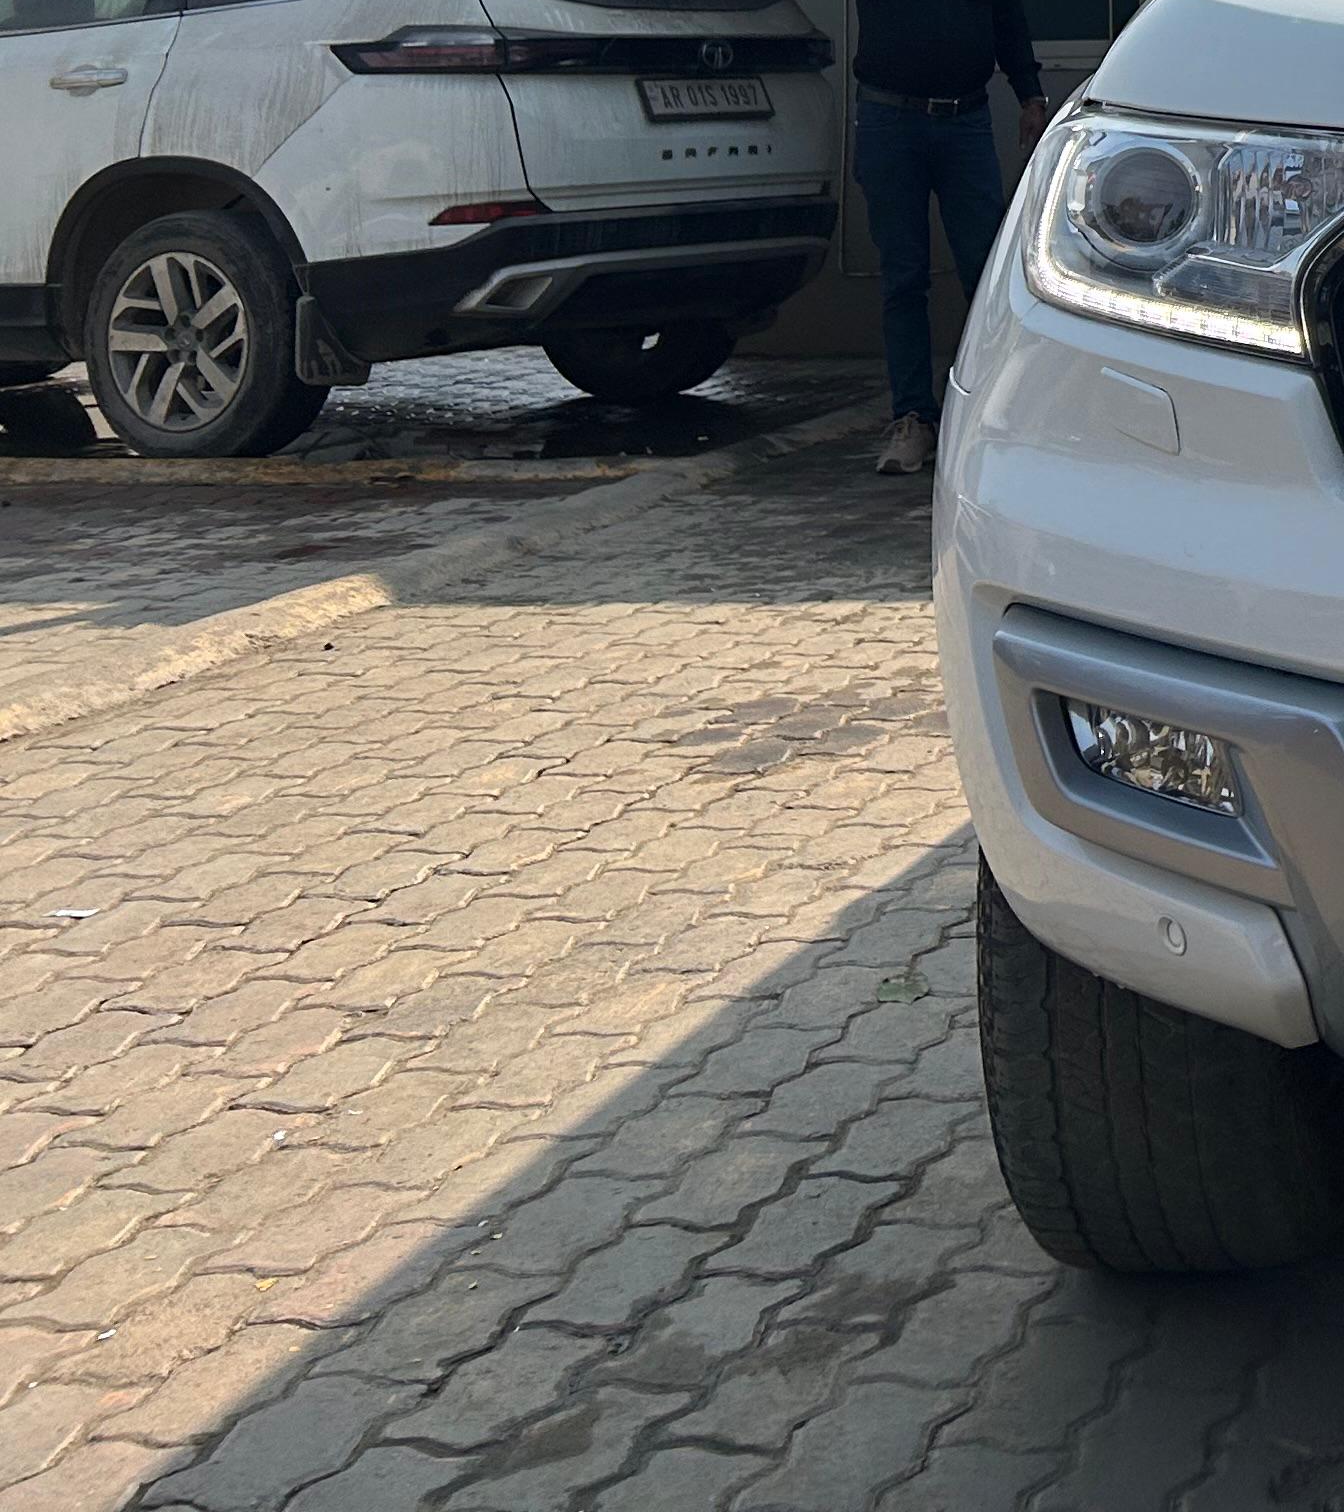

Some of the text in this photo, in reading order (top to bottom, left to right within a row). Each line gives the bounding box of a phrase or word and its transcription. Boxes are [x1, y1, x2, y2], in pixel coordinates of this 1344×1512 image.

[660, 83, 759, 109] AR 01S 1997
